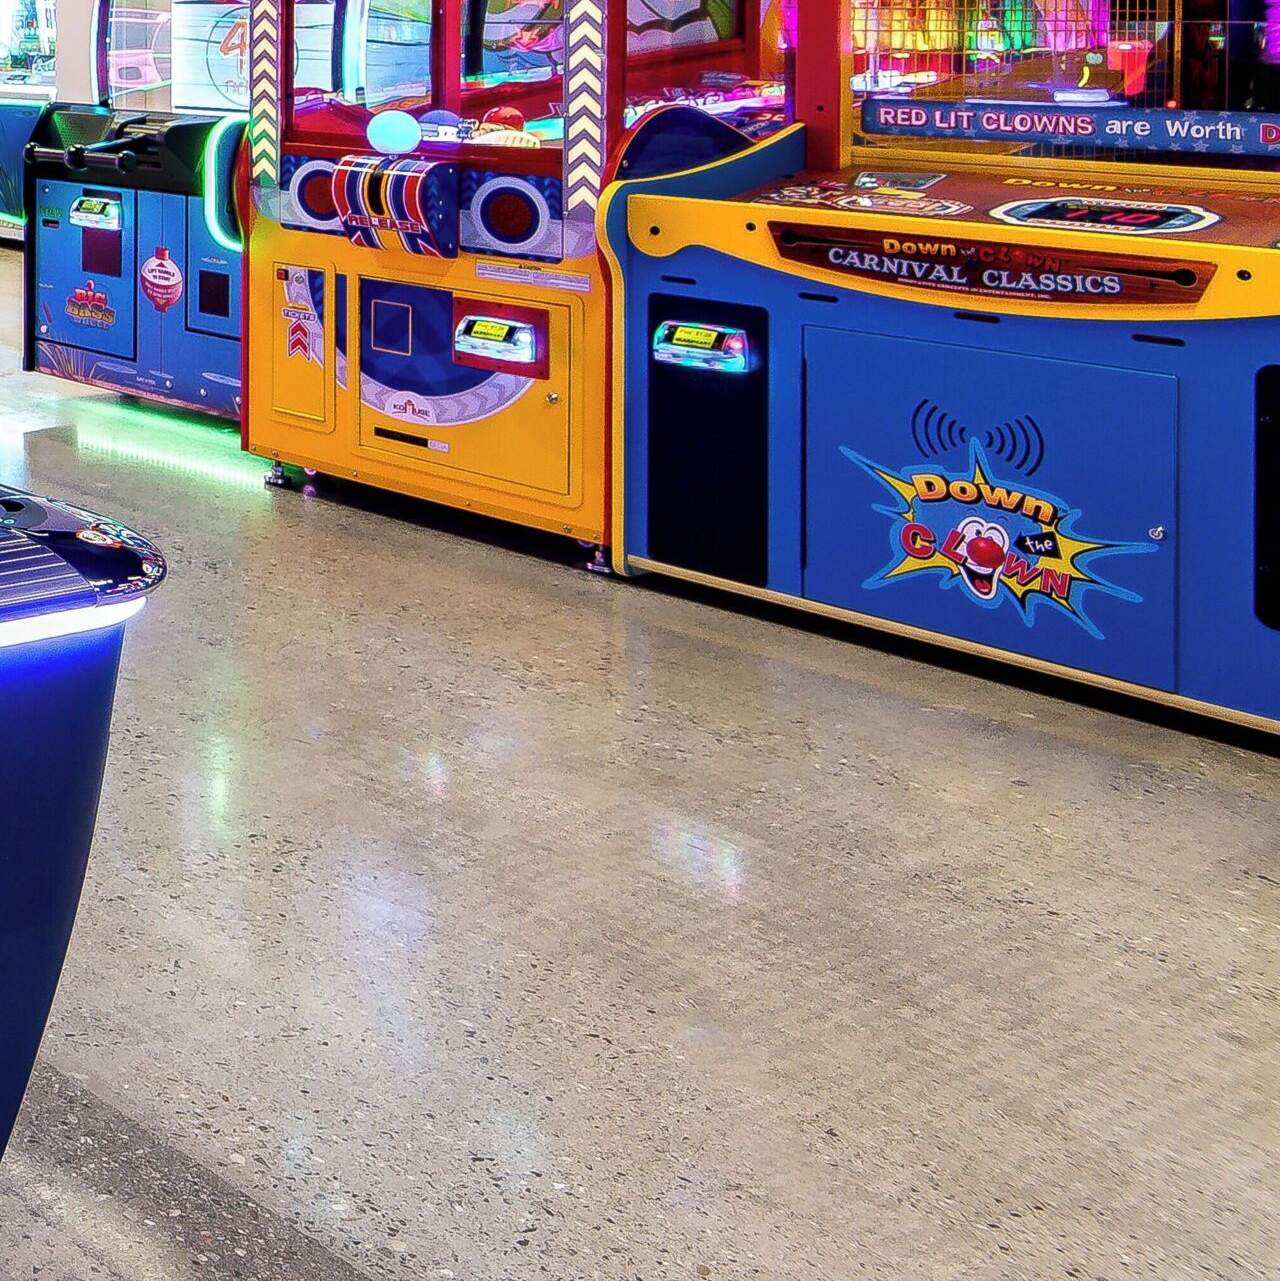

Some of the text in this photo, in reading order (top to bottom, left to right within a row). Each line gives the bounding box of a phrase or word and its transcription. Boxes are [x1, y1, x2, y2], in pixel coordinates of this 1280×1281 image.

[879, 106, 929, 127] RED
[934, 109, 974, 131] LIT
[981, 112, 1096, 137] CLOWNS
[1105, 118, 1152, 136] are
[1165, 119, 1242, 141] Worth
[348, 214, 422, 234] RELEASE
[828, 247, 1122, 295] CARNIVAL CLASSICS
[75, 288, 106, 306] BIG
[66, 297, 116, 324] BASS
[283, 308, 317, 321] TICKETS
[1024, 537, 1054, 554] the
